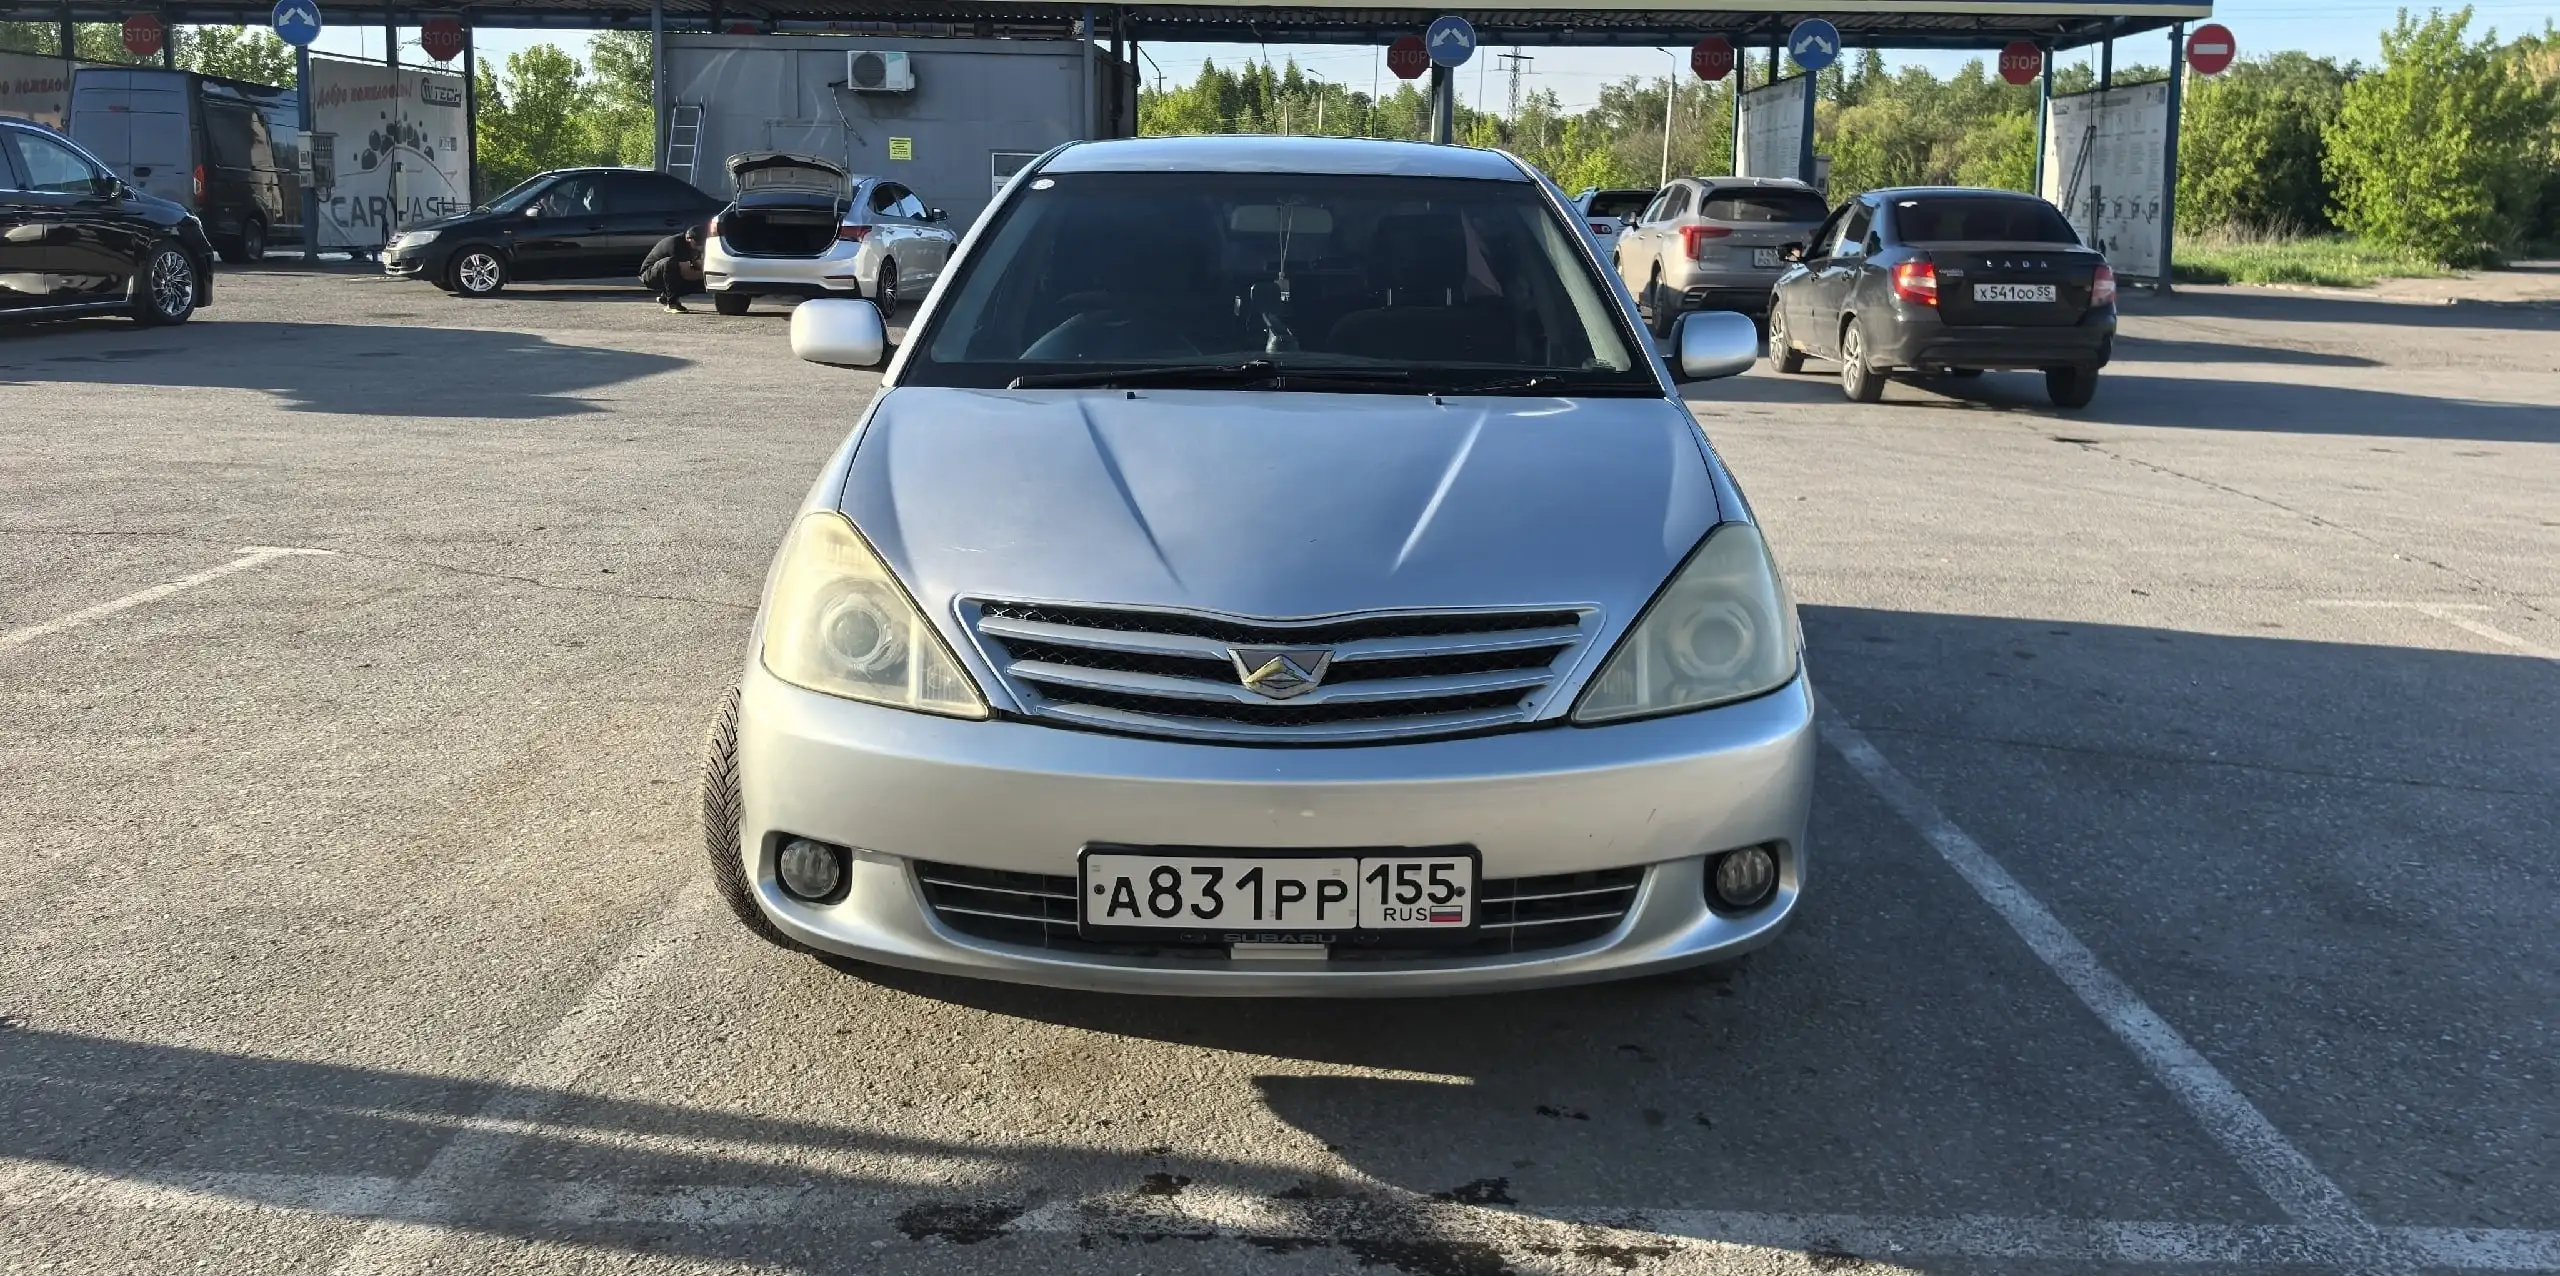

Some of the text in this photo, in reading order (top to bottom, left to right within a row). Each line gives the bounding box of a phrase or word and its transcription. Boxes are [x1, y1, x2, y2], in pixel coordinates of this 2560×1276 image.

[125, 28, 162, 42] STOP
[424, 31, 462, 46] STOP
[1390, 50, 1427, 64] STOP
[1694, 52, 1732, 66] STOP
[2002, 56, 2040, 70] STOP
[1986, 260, 2048, 268] LADA
[1365, 863, 1456, 906] 155
[1383, 906, 1428, 922] RUS
[1222, 932, 1338, 944] SUBARU
